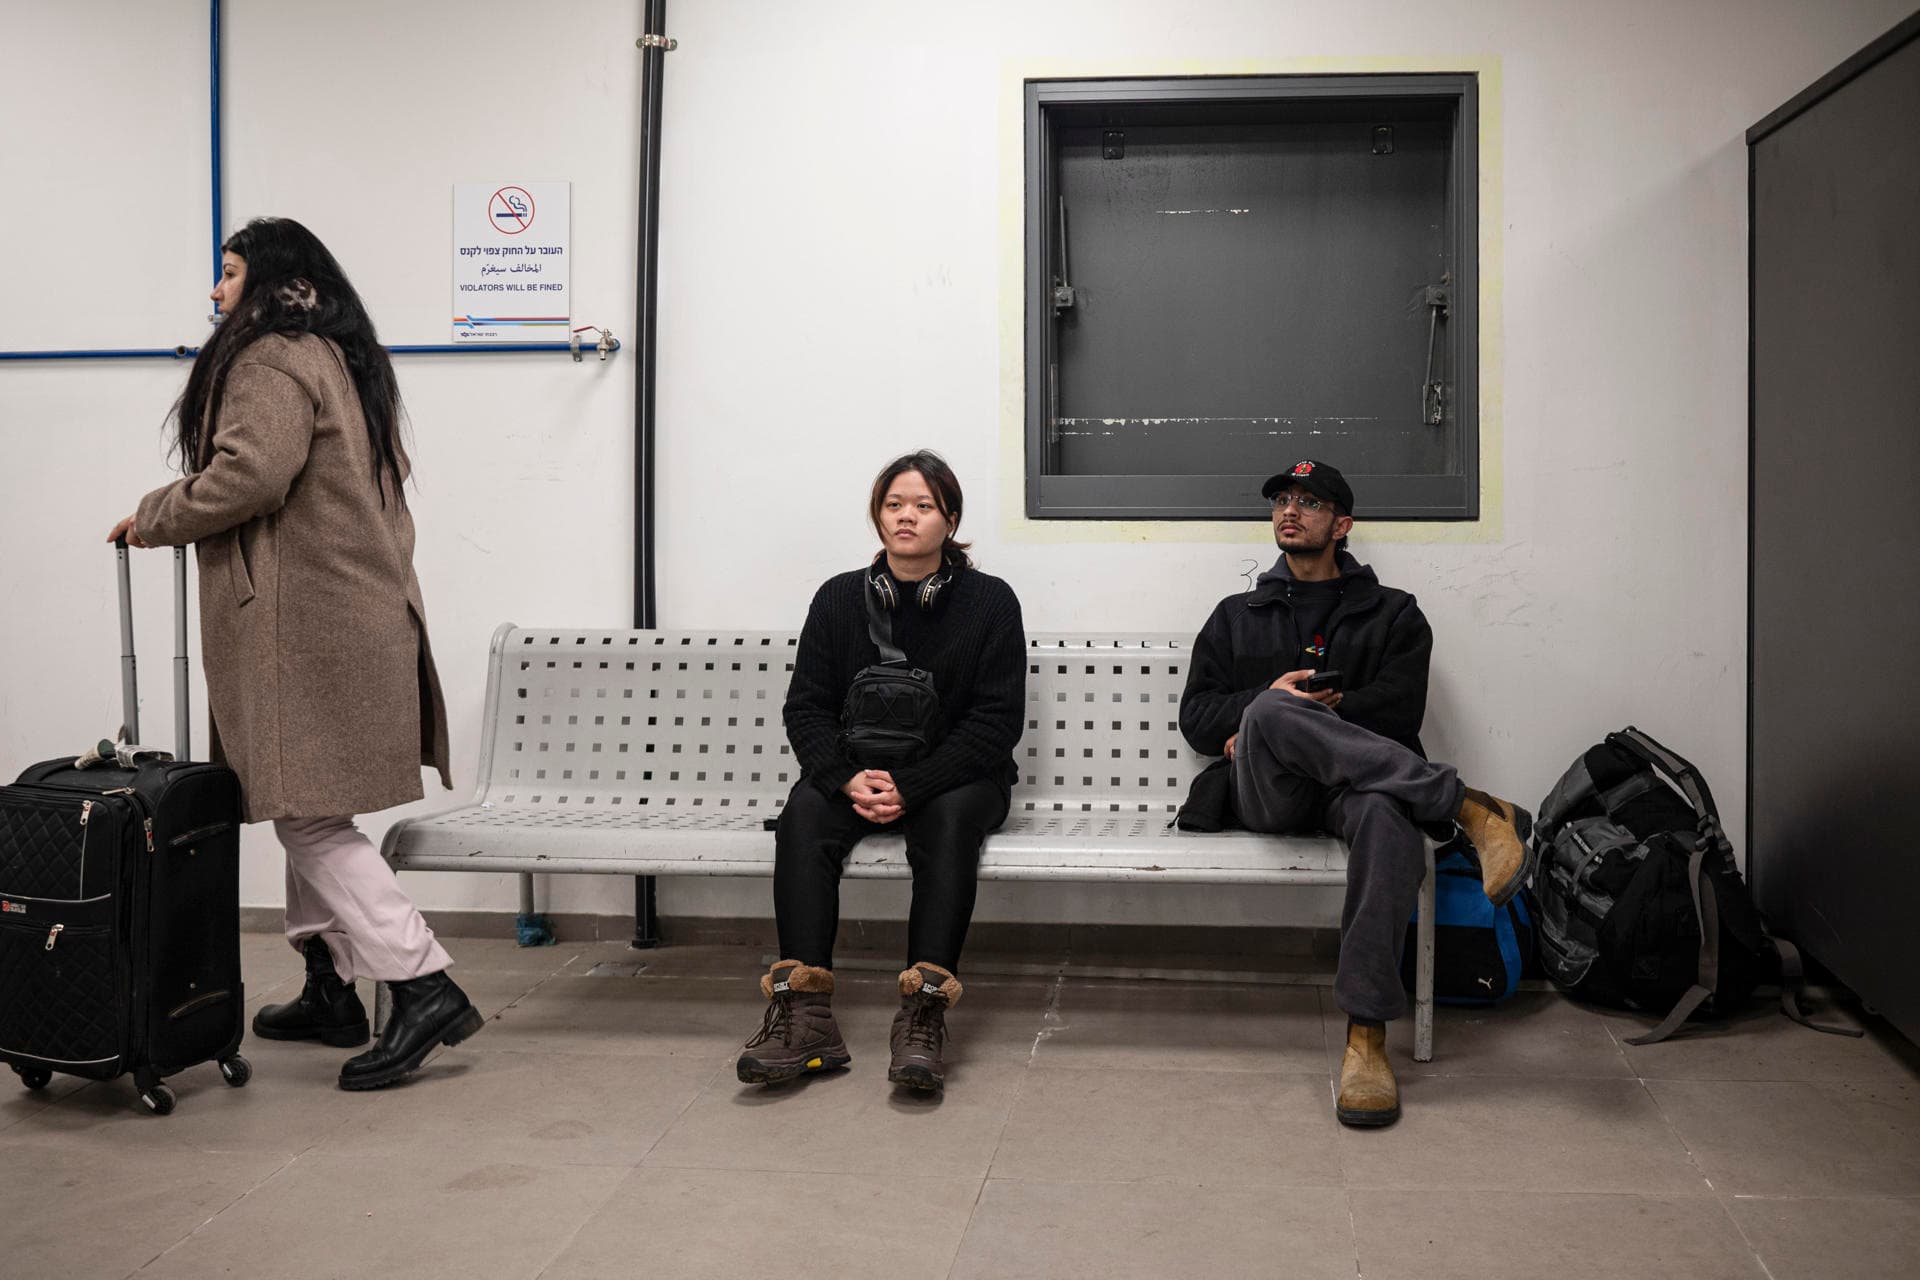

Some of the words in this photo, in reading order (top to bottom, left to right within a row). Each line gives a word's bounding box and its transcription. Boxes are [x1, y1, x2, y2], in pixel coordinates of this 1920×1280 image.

[460, 245, 482, 257] לקנס
[483, 246, 500, 256] צפוי
[502, 246, 523, 257] החוק
[525, 245, 537, 255] על
[539, 246, 563, 255] העובר
[510, 263, 541, 273] المخالف
[460, 284, 504, 292] VIOLATORS
[539, 283, 563, 291] FINED
